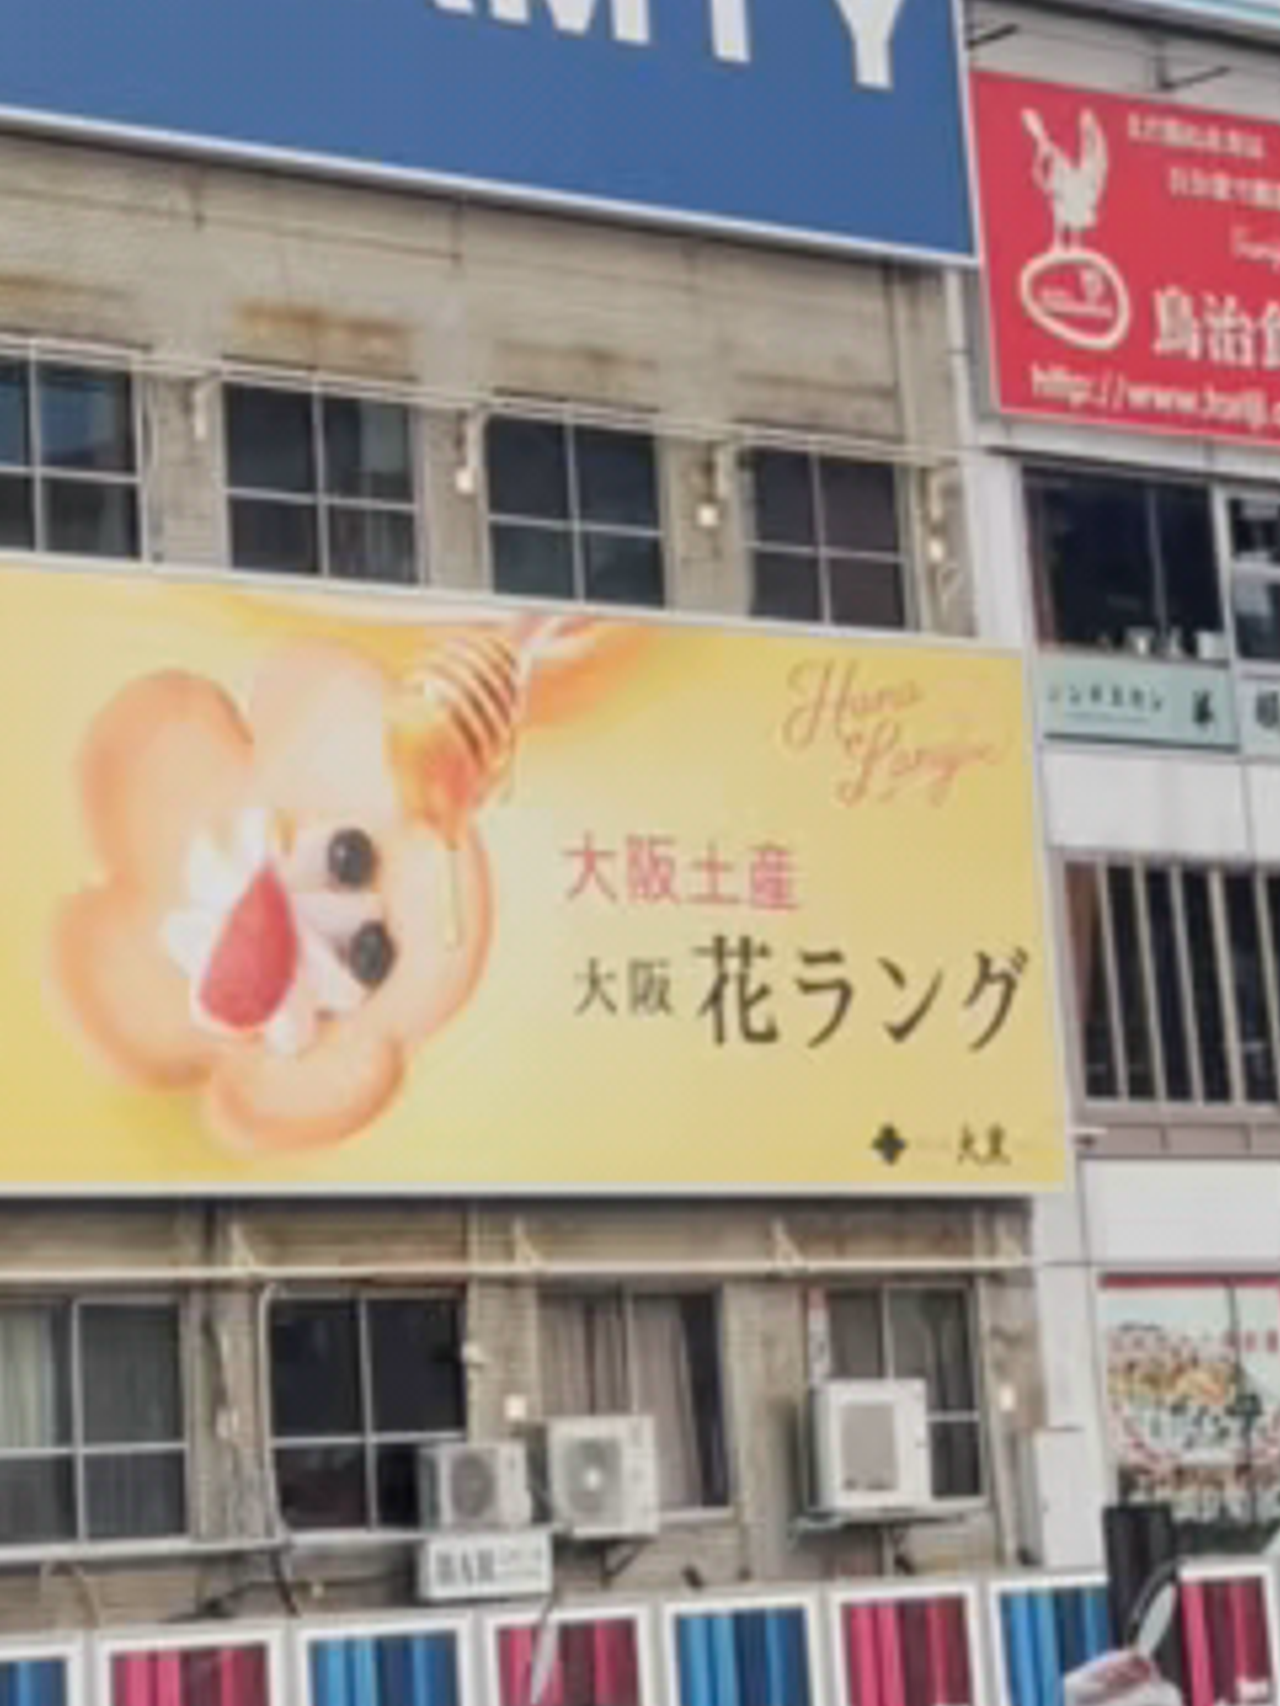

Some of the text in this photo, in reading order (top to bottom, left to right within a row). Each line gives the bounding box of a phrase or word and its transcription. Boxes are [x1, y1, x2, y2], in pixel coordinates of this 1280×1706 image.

[561, 830, 799, 913] 大阪土産
[573, 932, 1031, 1053] 大阪 花ラング
